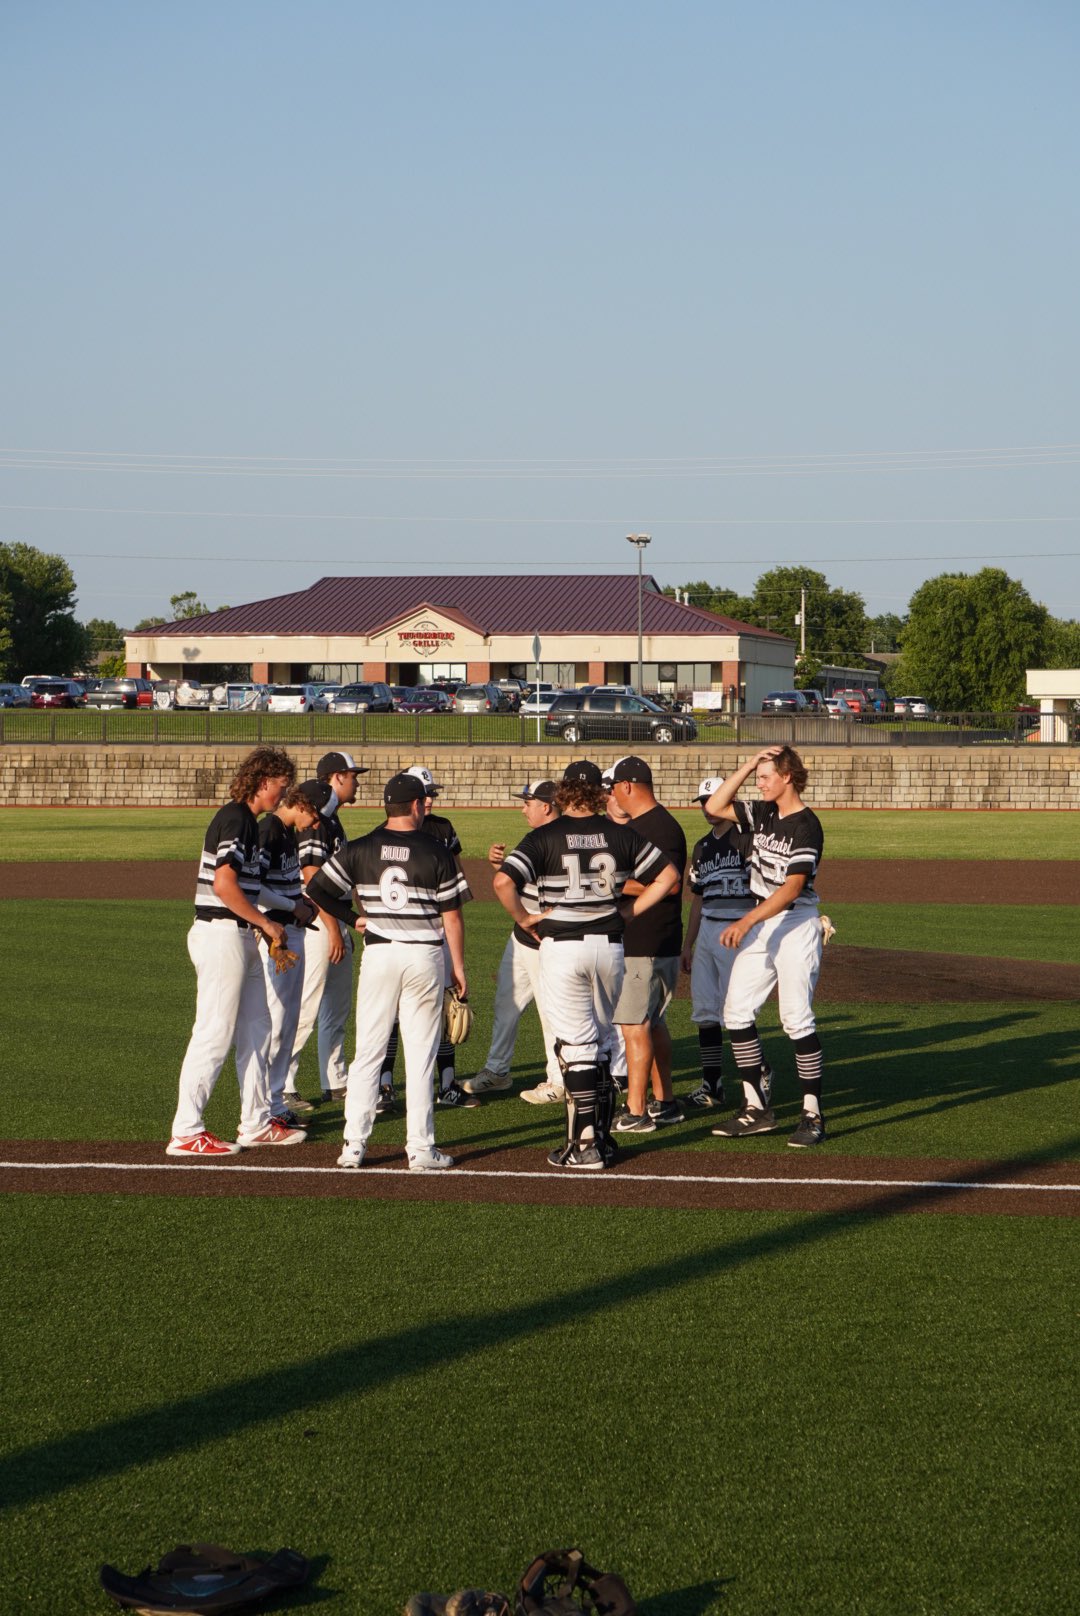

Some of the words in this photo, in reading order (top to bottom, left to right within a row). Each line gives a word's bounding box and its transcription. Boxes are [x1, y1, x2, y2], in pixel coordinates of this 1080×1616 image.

[561, 852, 617, 899] 13
[379, 865, 409, 911] 6
[721, 876, 745, 896] 14
[190, 1139, 209, 1153] N
[262, 1131, 281, 1142] N
